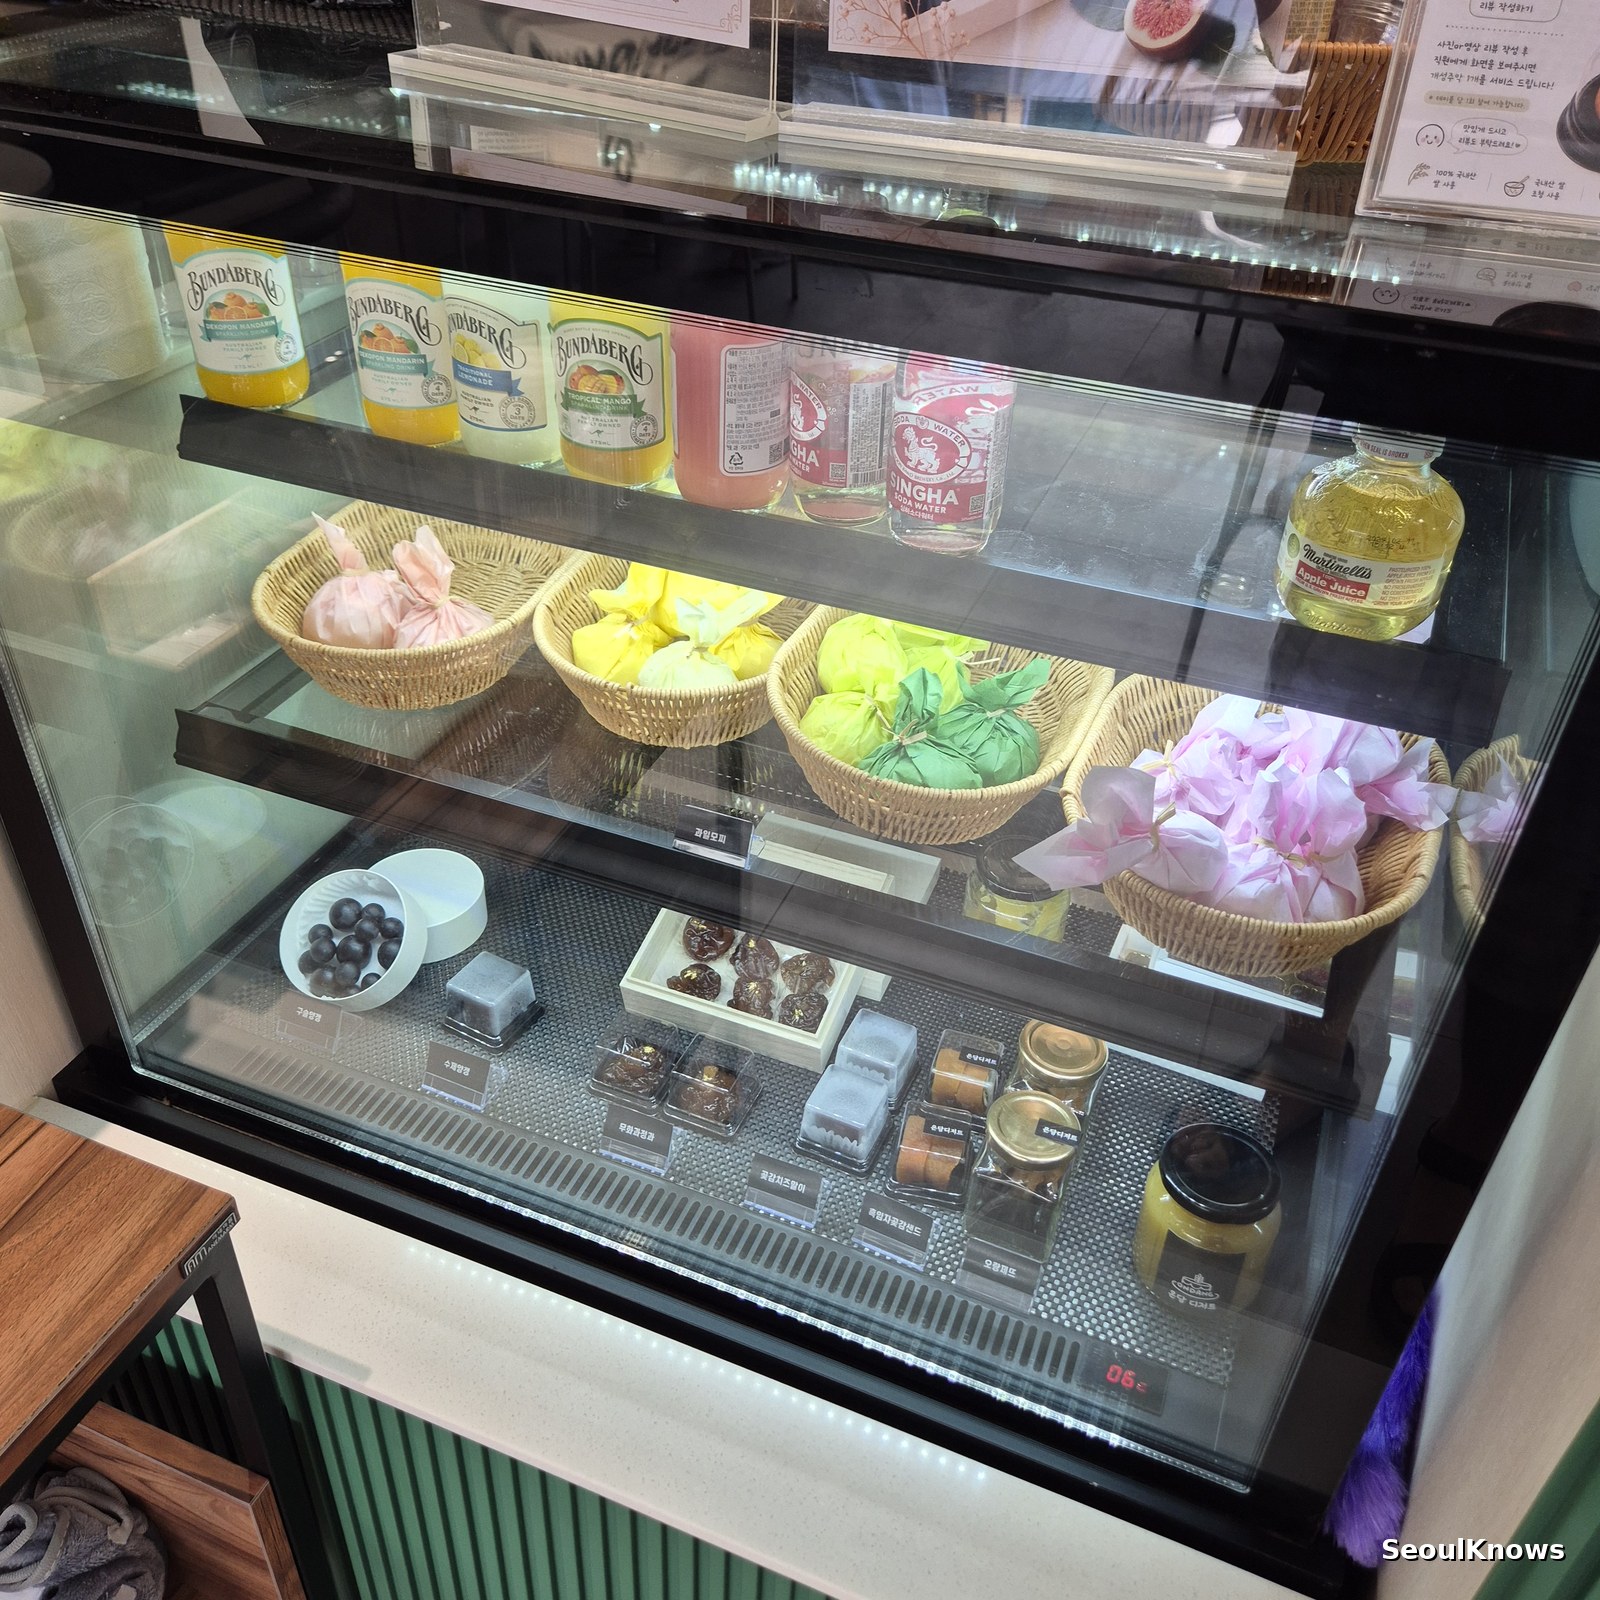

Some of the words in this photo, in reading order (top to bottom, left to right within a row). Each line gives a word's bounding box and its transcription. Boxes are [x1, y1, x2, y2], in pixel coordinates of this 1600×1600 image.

[1479, 1, 1495, 10] 리뷰
[1499, 2, 1534, 13] 작성하기
[1437, 41, 1481, 53] 사진or영상
[1484, 45, 1499, 53] 리뷰
[1502, 44, 1519, 56] 작성
[1521, 46, 1529, 56] 후
[1434, 55, 1468, 66] 직원에게
[1471, 58, 1495, 70] 화면을
[1497, 60, 1537, 73] 보여주시면
[1490, 76, 1514, 87] 서비스
[1517, 79, 1555, 90] 드립니다!
[1463, 124, 1485, 134] 맛있게
[1488, 127, 1507, 136] 드시고
[1458, 137, 1477, 146] 리뷰도
[1436, 169, 1454, 178] 100%
[1456, 170, 1477, 180] 국내산
[1443, 181, 1456, 190] 사용
[1534, 178, 1555, 189] 국내산
[1547, 192, 1560, 201] 사용
[187, 262, 286, 311] BUNDABERG
[206, 323, 238, 331] DEKOPON
[240, 320, 276, 330] MANDARIN
[349, 292, 442, 346] BUNDABERG
[448, 311, 527, 369] NDABERG
[386, 356, 425, 364] MANDARIN
[556, 332, 653, 386] BUNDABERG
[459, 371, 493, 386] LEMONADE
[568, 392, 601, 404] TROPICAL
[602, 397, 632, 405] MANGO
[800, 383, 822, 410] WATER
[933, 423, 966, 448] WATER
[791, 439, 820, 467] GHA
[1371, 444, 1383, 456] SEAL
[1382, 448, 1388, 457] IS
[1388, 450, 1409, 459] BROKEN
[890, 472, 959, 505] SINGHA
[895, 493, 913, 507] SODA
[914, 503, 947, 514] WATER
[1297, 566, 1327, 588] Apple
[1329, 582, 1366, 598] Juice
[296, 1006, 322, 1023] 구슬양갱
[966, 1053, 997, 1065] 온당디저트
[444, 1060, 471, 1076] 수제양갱
[618, 1122, 656, 1142] 무화과정과
[930, 1124, 964, 1136] 온당디저트
[1042, 1126, 1078, 1142] 온당디저트
[760, 1169, 806, 1194] 곶감치즈말이
[868, 1207, 922, 1237] 흑임자곶감샌드
[1177, 1281, 1214, 1297] ONDANG
[1168, 1289, 1188, 1304] 온당
[1188, 1300, 1217, 1310] 디저트
[1106, 1364, 1137, 1389] 06
